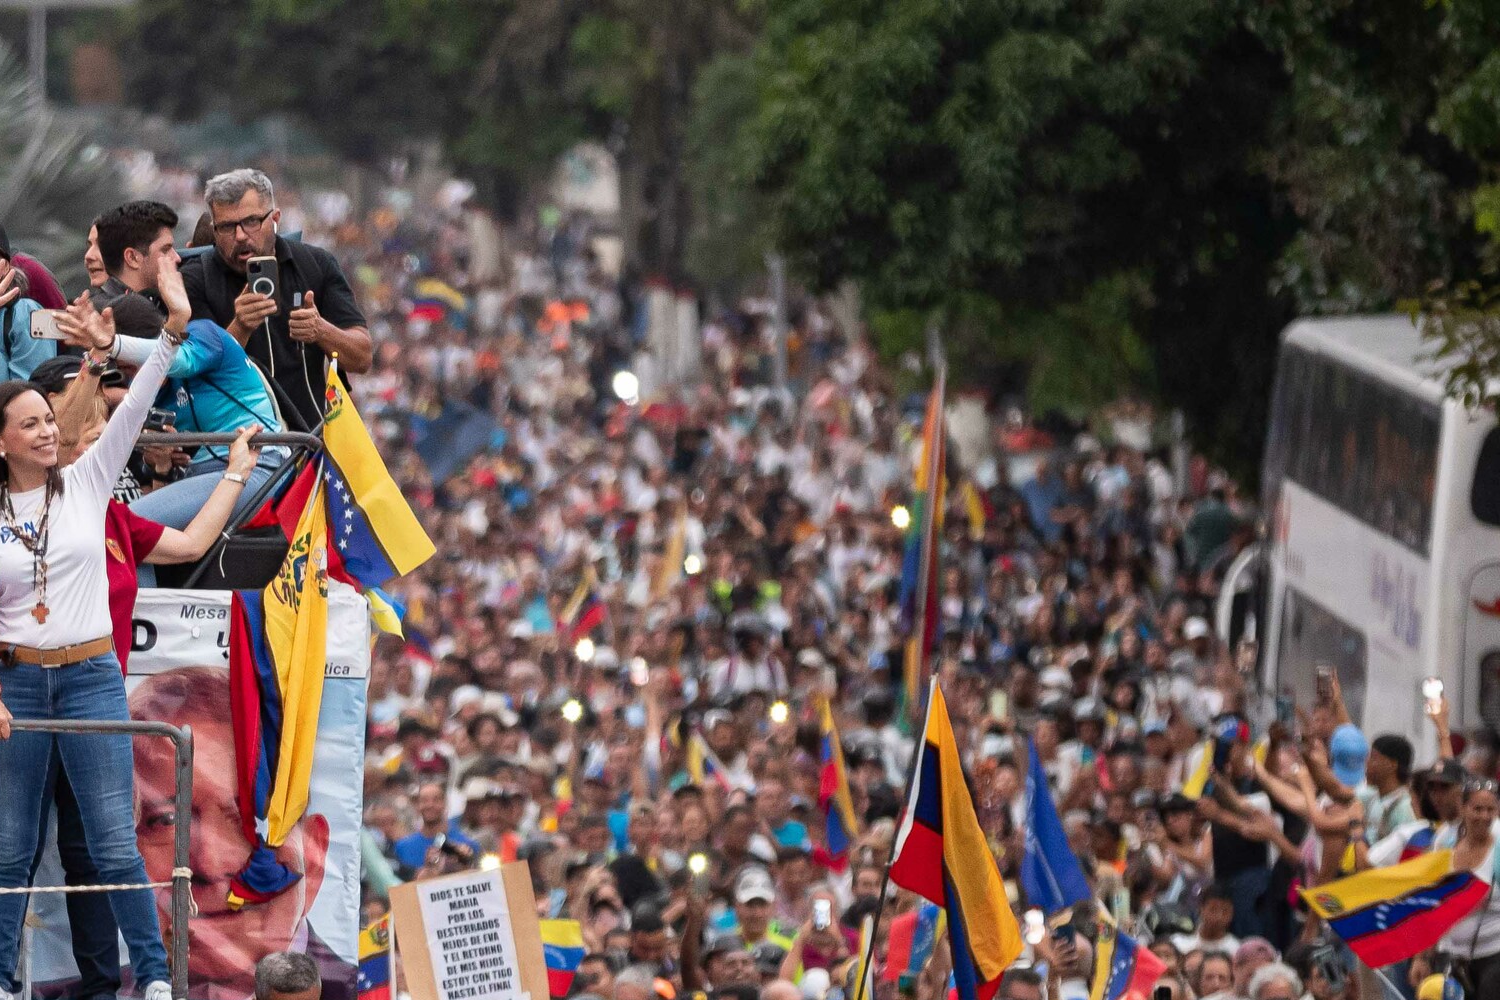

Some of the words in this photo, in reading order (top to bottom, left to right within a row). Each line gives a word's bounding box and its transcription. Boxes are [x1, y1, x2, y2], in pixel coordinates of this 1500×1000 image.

[180, 605, 227, 619] Mesa
[430, 889, 452, 902] DIOS
[454, 887, 464, 897] TE
[466, 882, 492, 895] SALVE
[449, 897, 479, 911] MARIA
[448, 912, 466, 924] POR
[468, 909, 485, 920] LOS
[437, 918, 500, 940] DESTERRADOS
[470, 935, 481, 946] DE
[483, 931, 499, 943] EVA
[451, 952, 460, 962] EL
[462, 944, 503, 960] RETORNO
[447, 965, 457, 976] DE
[460, 961, 477, 973] MIS
[443, 976, 470, 990] ESTOY
[472, 972, 490, 984] CON
[492, 967, 512, 979] TIGO
[448, 987, 477, 1000] HASTA
[478, 985, 486, 995] EL
[489, 980, 512, 993] FINAL
